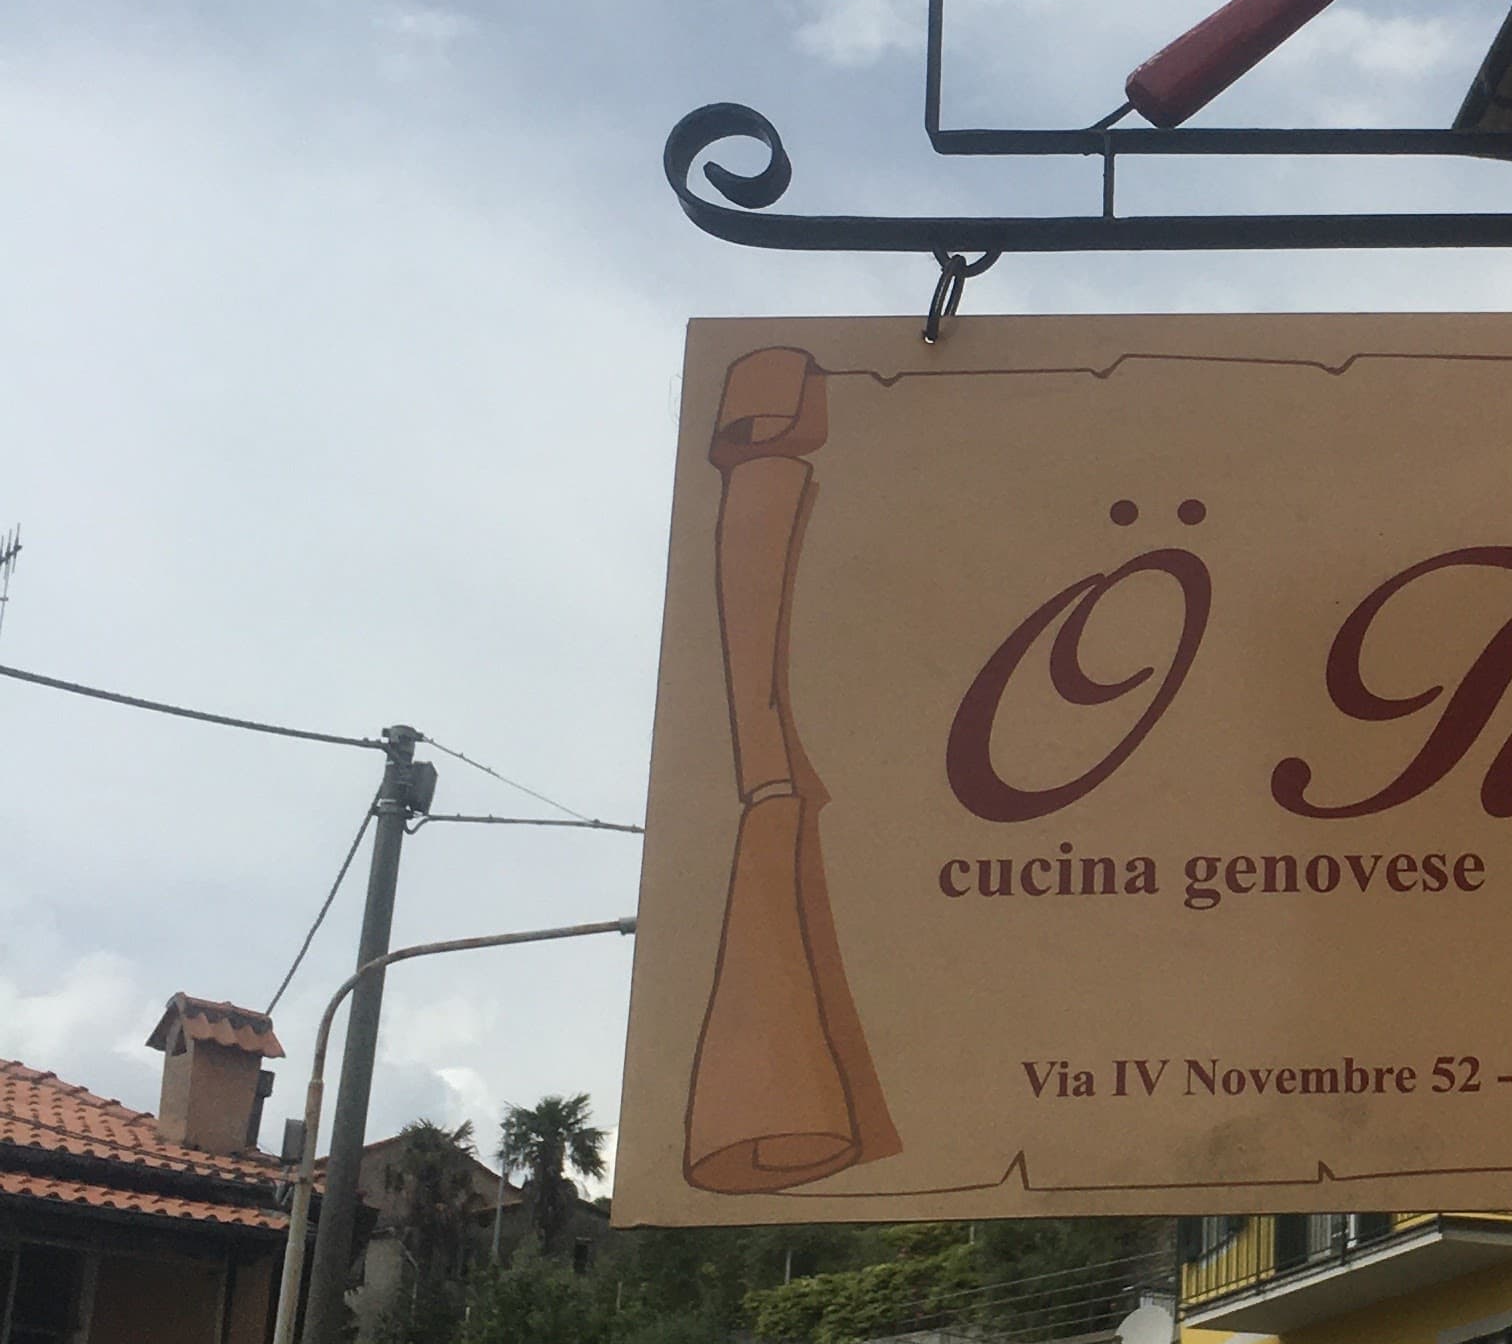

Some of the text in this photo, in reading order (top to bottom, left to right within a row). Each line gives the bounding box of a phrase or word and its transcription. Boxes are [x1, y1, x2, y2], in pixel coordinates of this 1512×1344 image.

[938, 842, 1486, 911] cucina genovese
[1021, 1059, 1096, 1099] Via
[1110, 1058, 1170, 1098] IV
[1183, 1056, 1418, 1097] Novembre
[1431, 1055, 1482, 1094] 52
